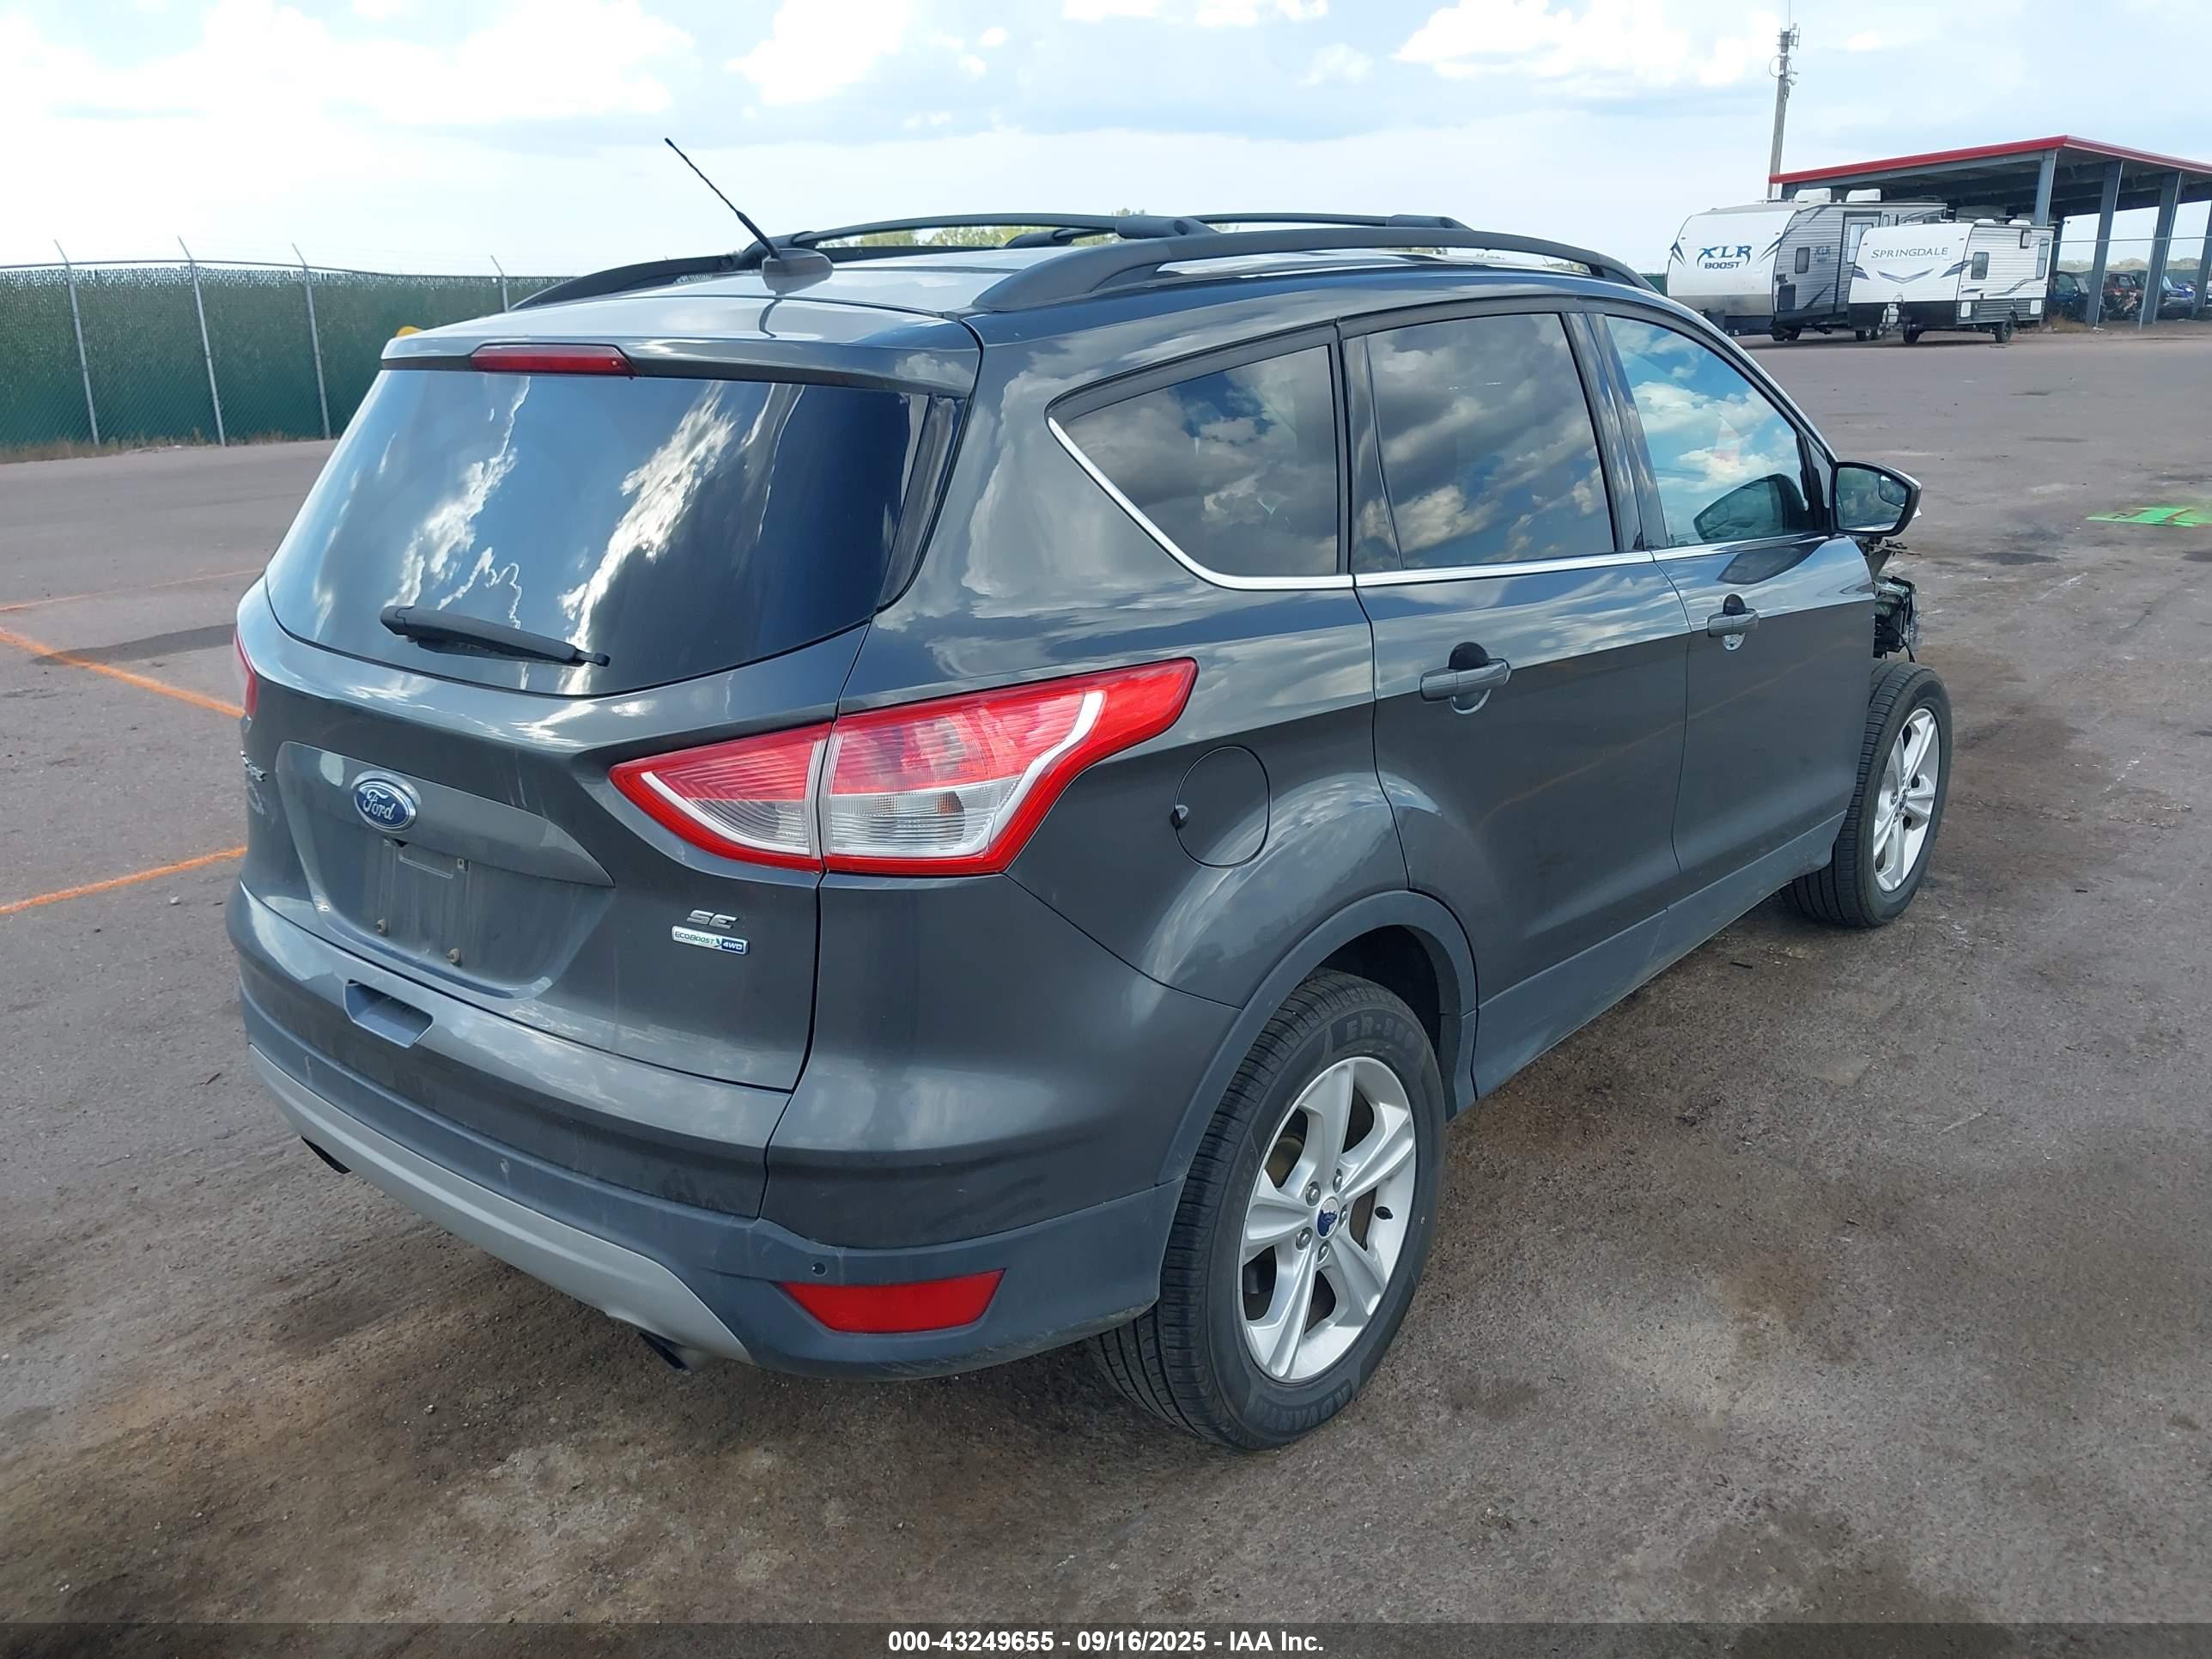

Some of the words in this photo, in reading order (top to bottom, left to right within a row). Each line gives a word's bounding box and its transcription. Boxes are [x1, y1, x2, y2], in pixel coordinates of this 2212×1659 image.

[1697, 246, 1752, 265] XLR
[1871, 247, 1948, 258] SPRINGDALE
[363, 789, 396, 820] Ford
[687, 909, 738, 929] SE
[722, 941, 743, 951] 4WD
